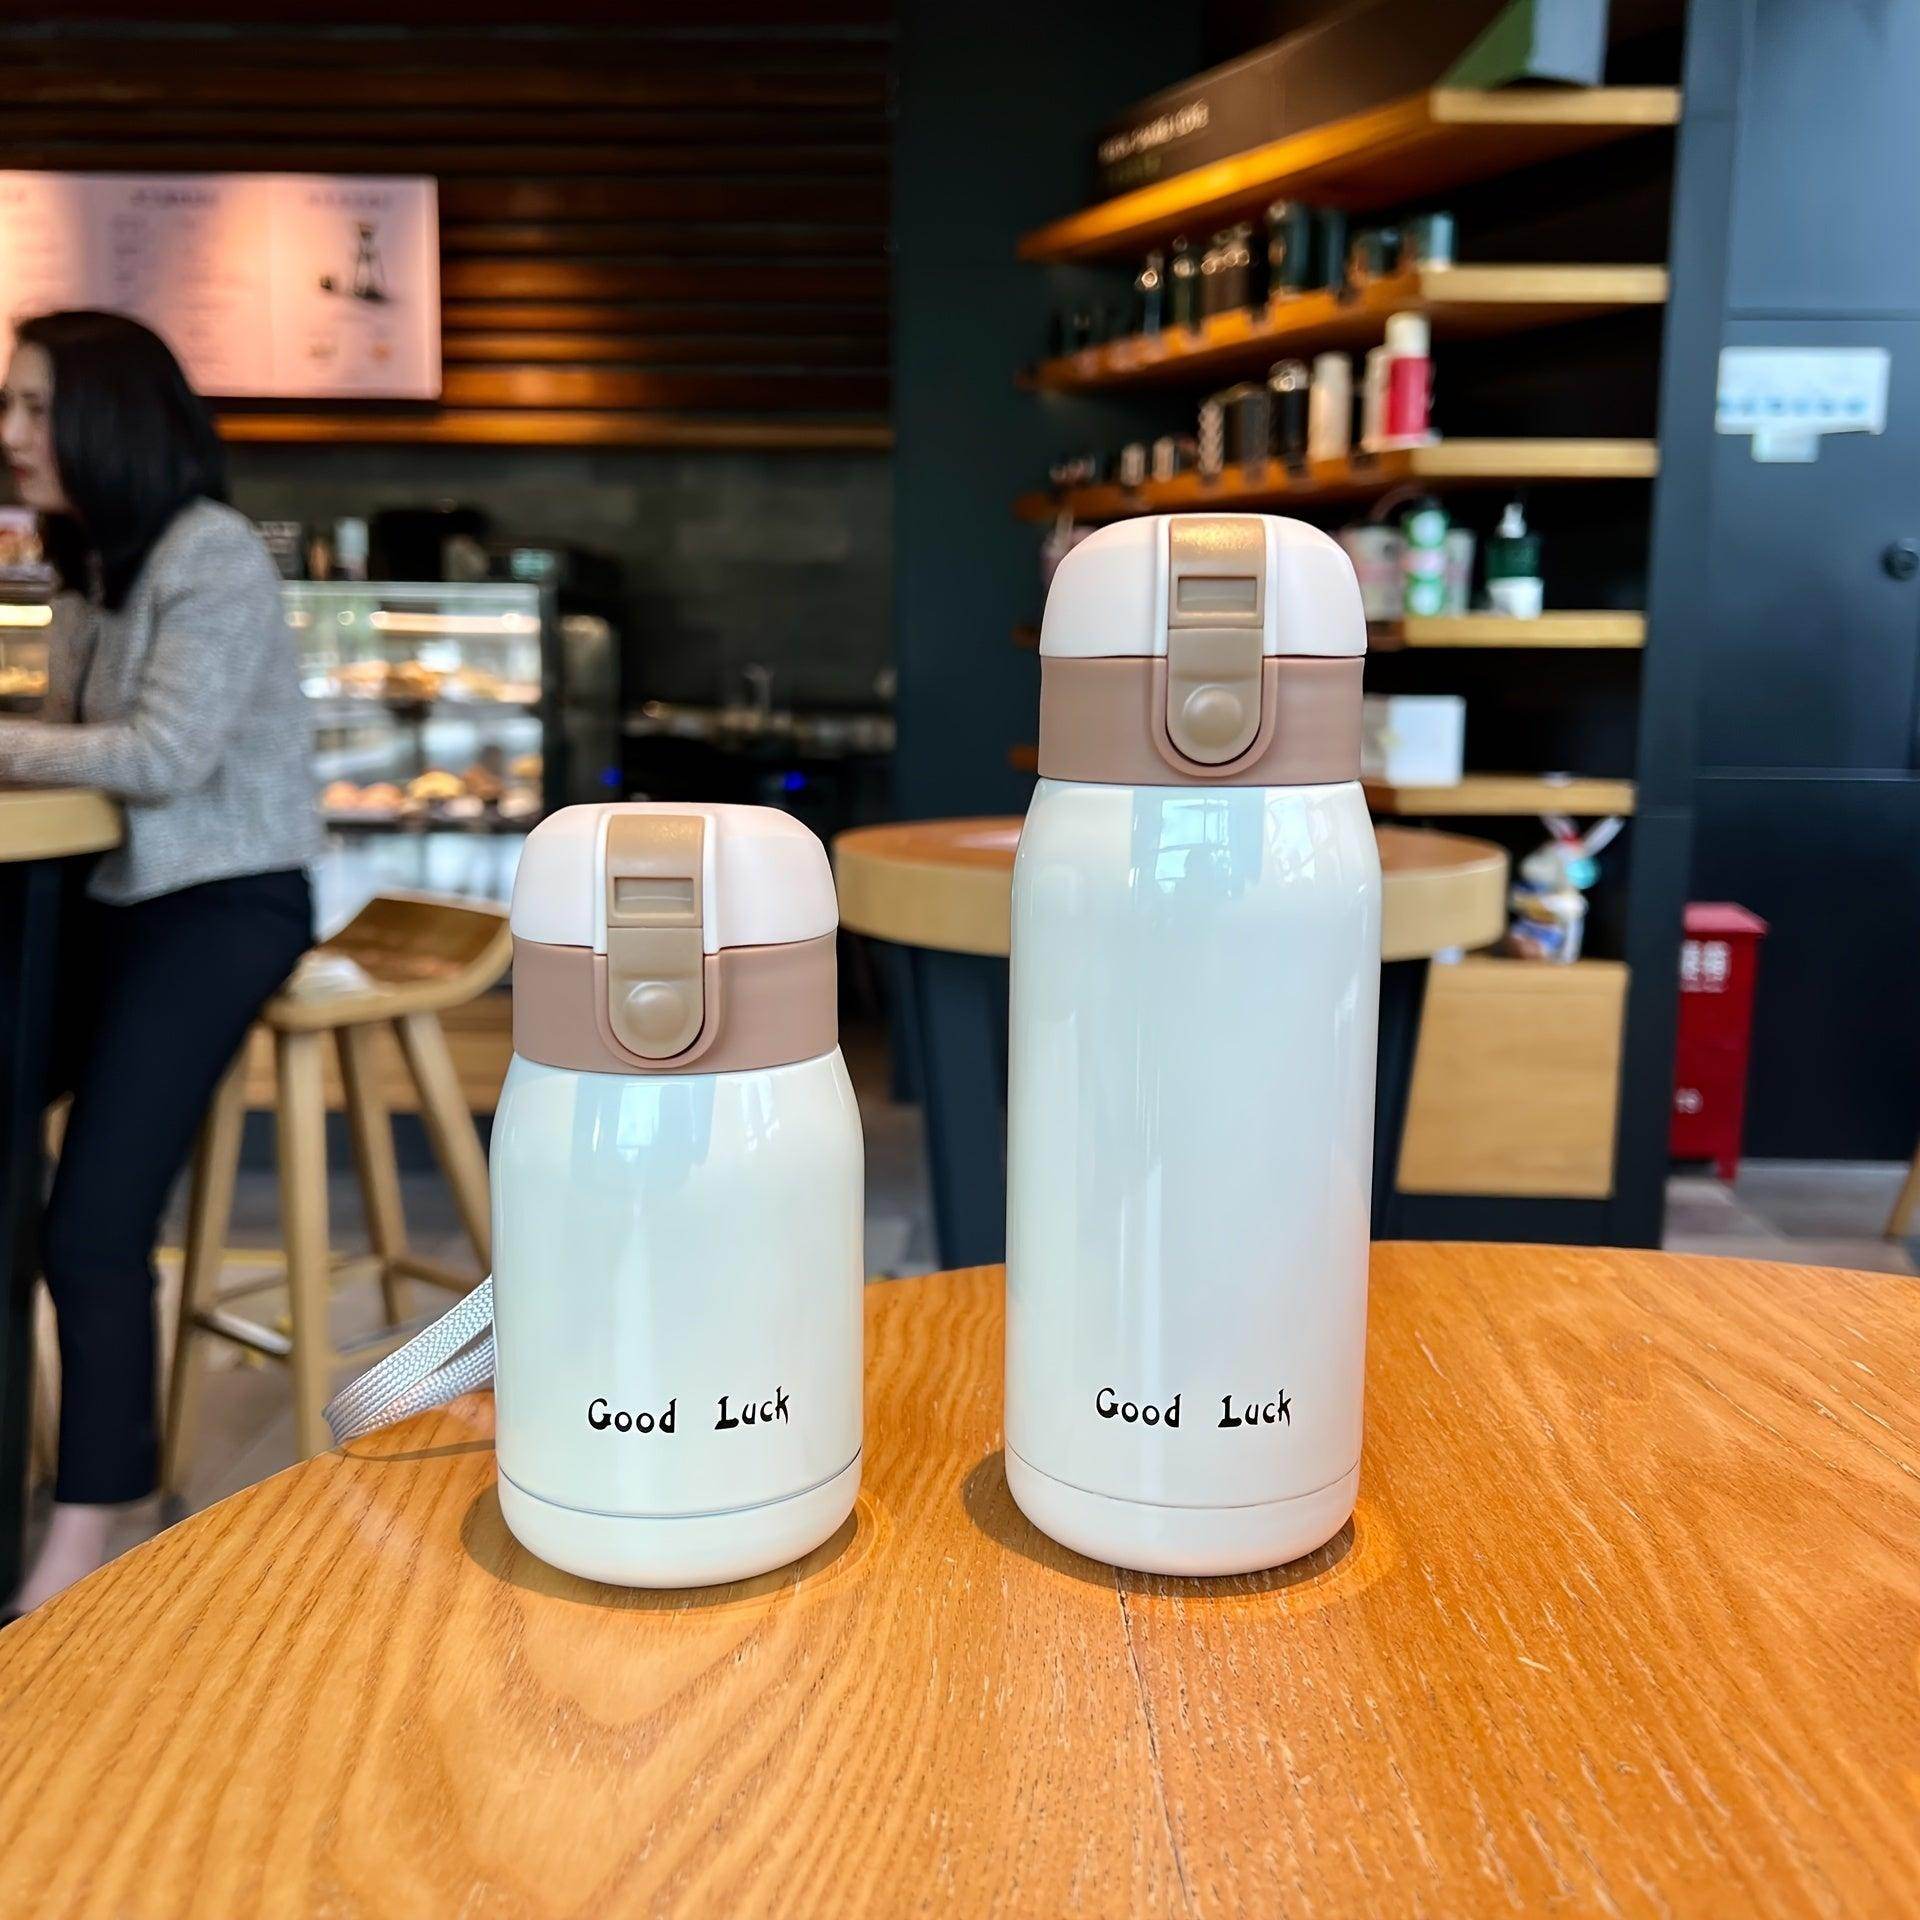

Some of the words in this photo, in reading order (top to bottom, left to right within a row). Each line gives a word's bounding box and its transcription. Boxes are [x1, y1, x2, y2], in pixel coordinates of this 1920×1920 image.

[587, 1397, 677, 1434] Good
[714, 1385, 790, 1430] Luck
[1096, 1387, 1182, 1428] Good
[1217, 1388, 1292, 1428] Luck
